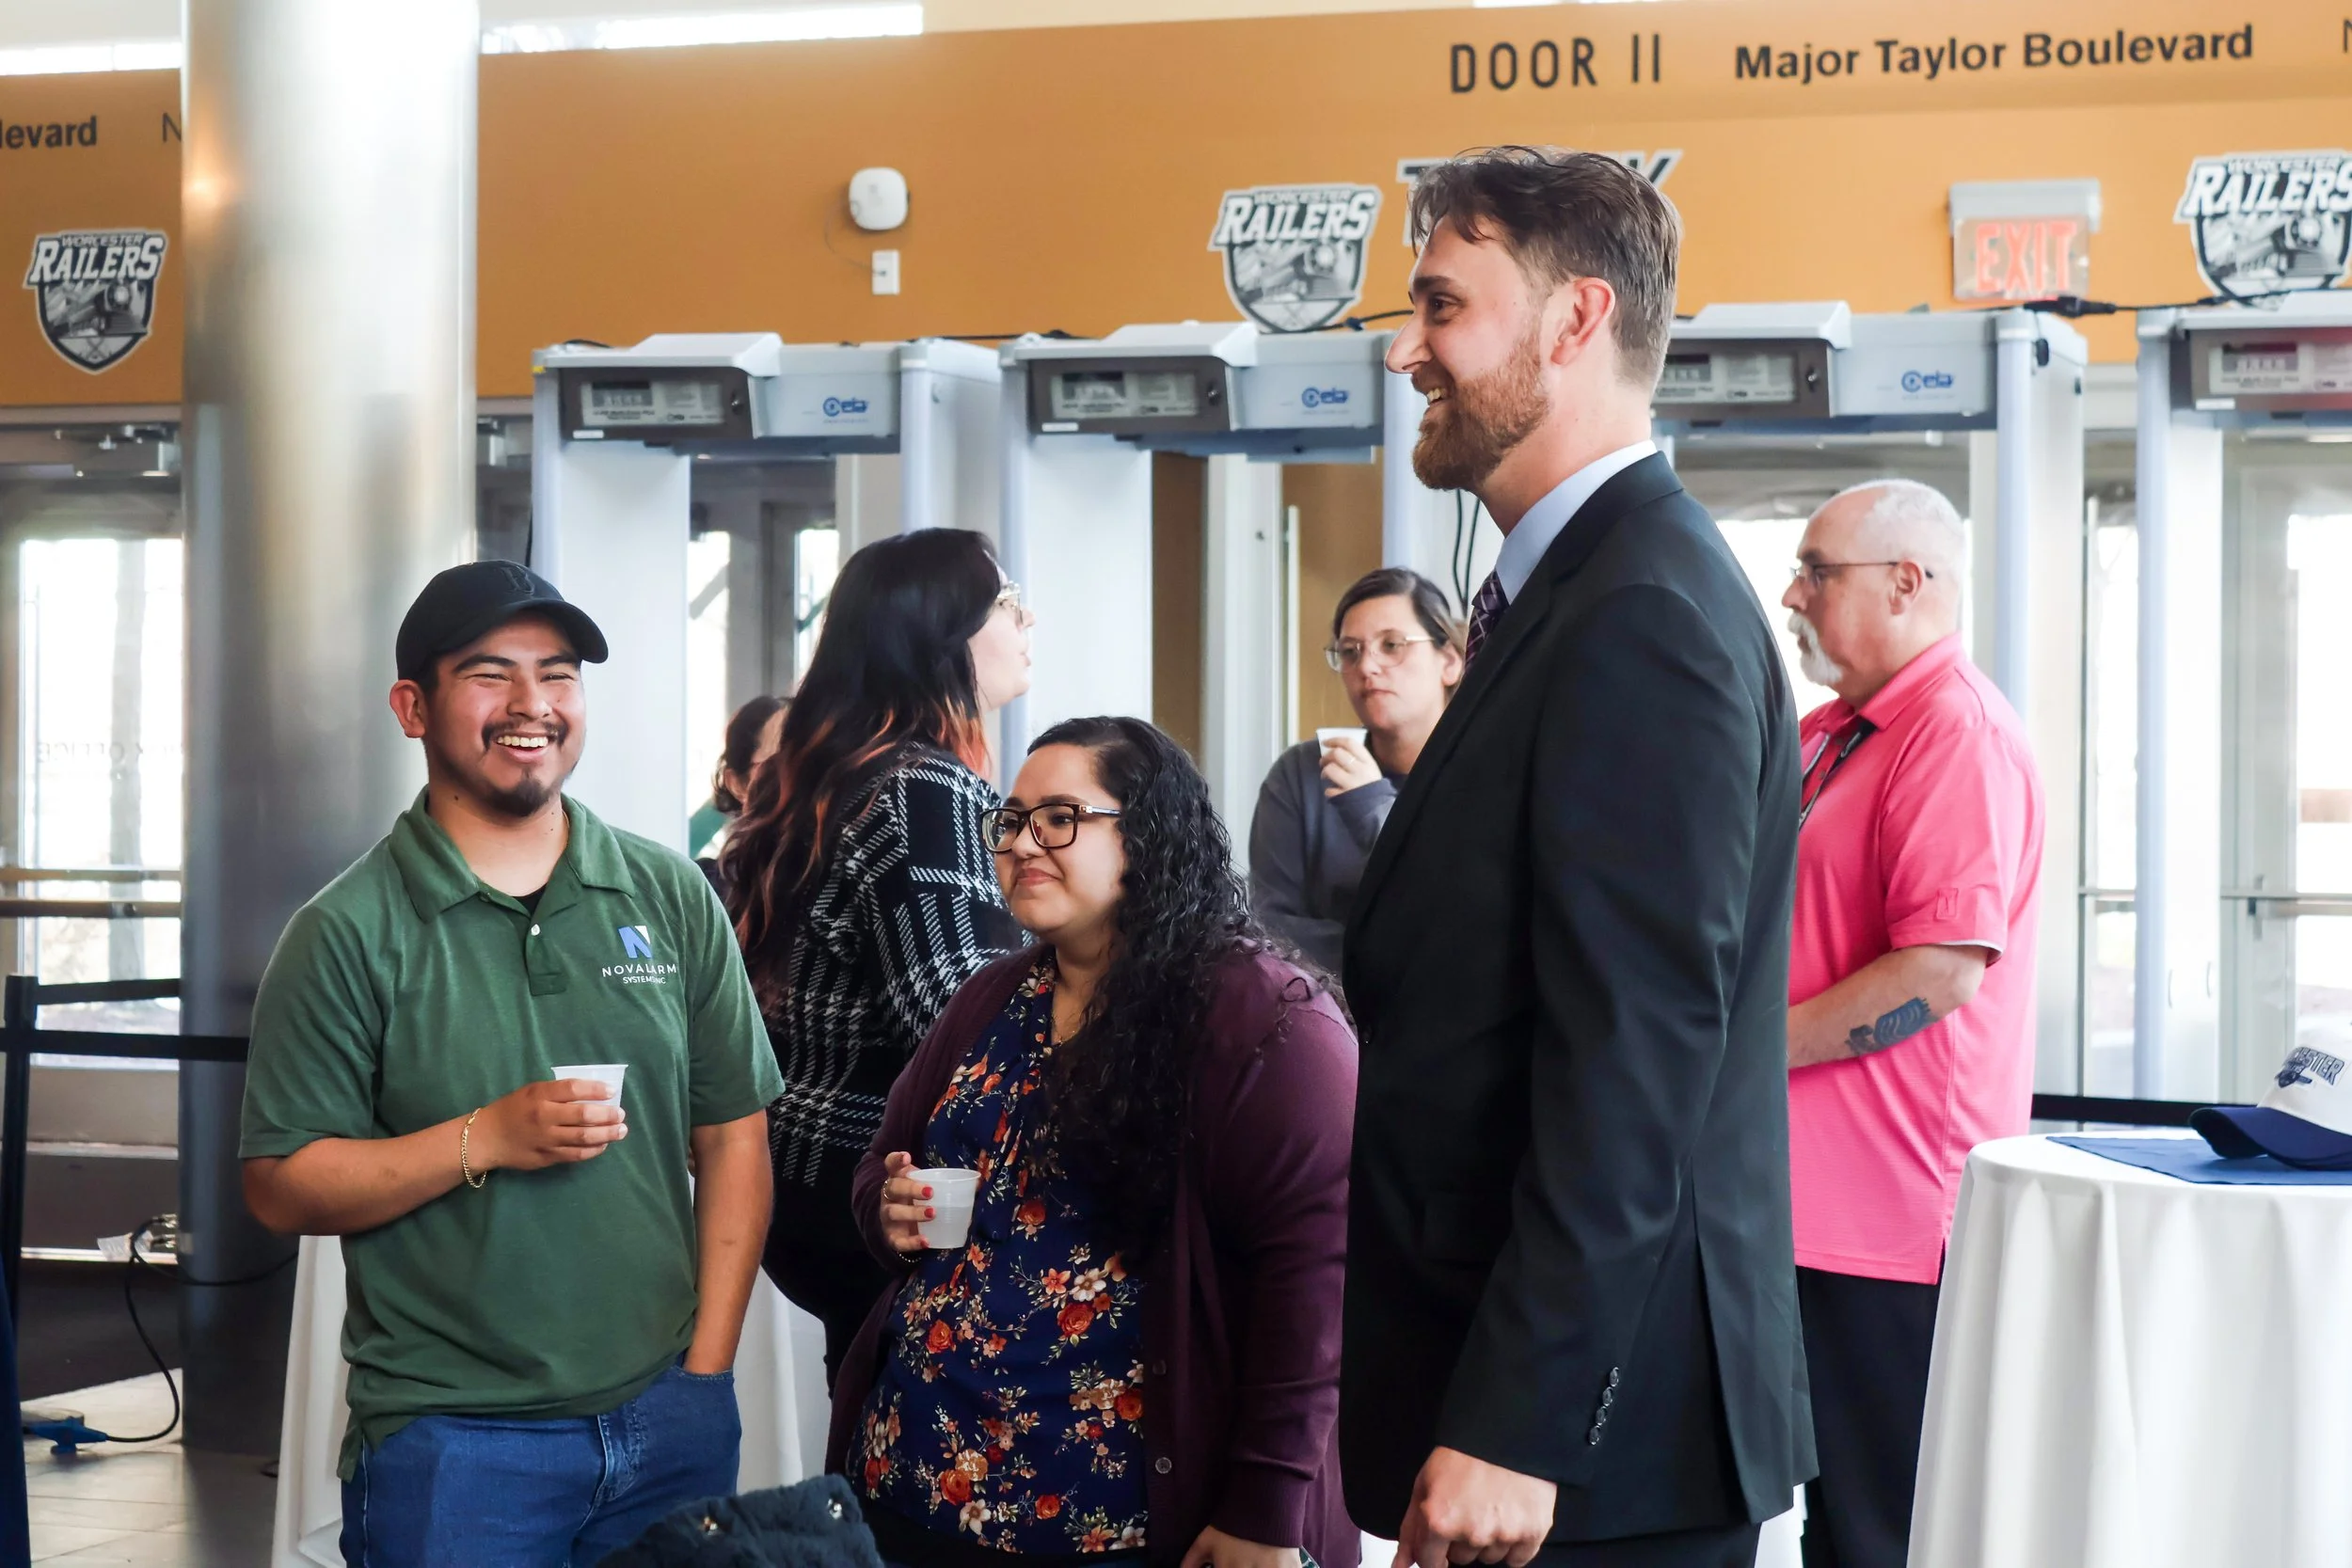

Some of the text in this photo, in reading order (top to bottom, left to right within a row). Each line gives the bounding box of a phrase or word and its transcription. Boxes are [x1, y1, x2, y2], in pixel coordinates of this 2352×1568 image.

[1450, 37, 1598, 94] DOOR
[1735, 23, 2253, 85] Major Taylor Boulevard
[2180, 158, 2352, 218] RAILERS
[1214, 191, 1375, 245] RAILERS
[29, 236, 165, 284] RAILERS
[1976, 220, 2077, 293] EXIT
[601, 963, 677, 977] NOVALARM
